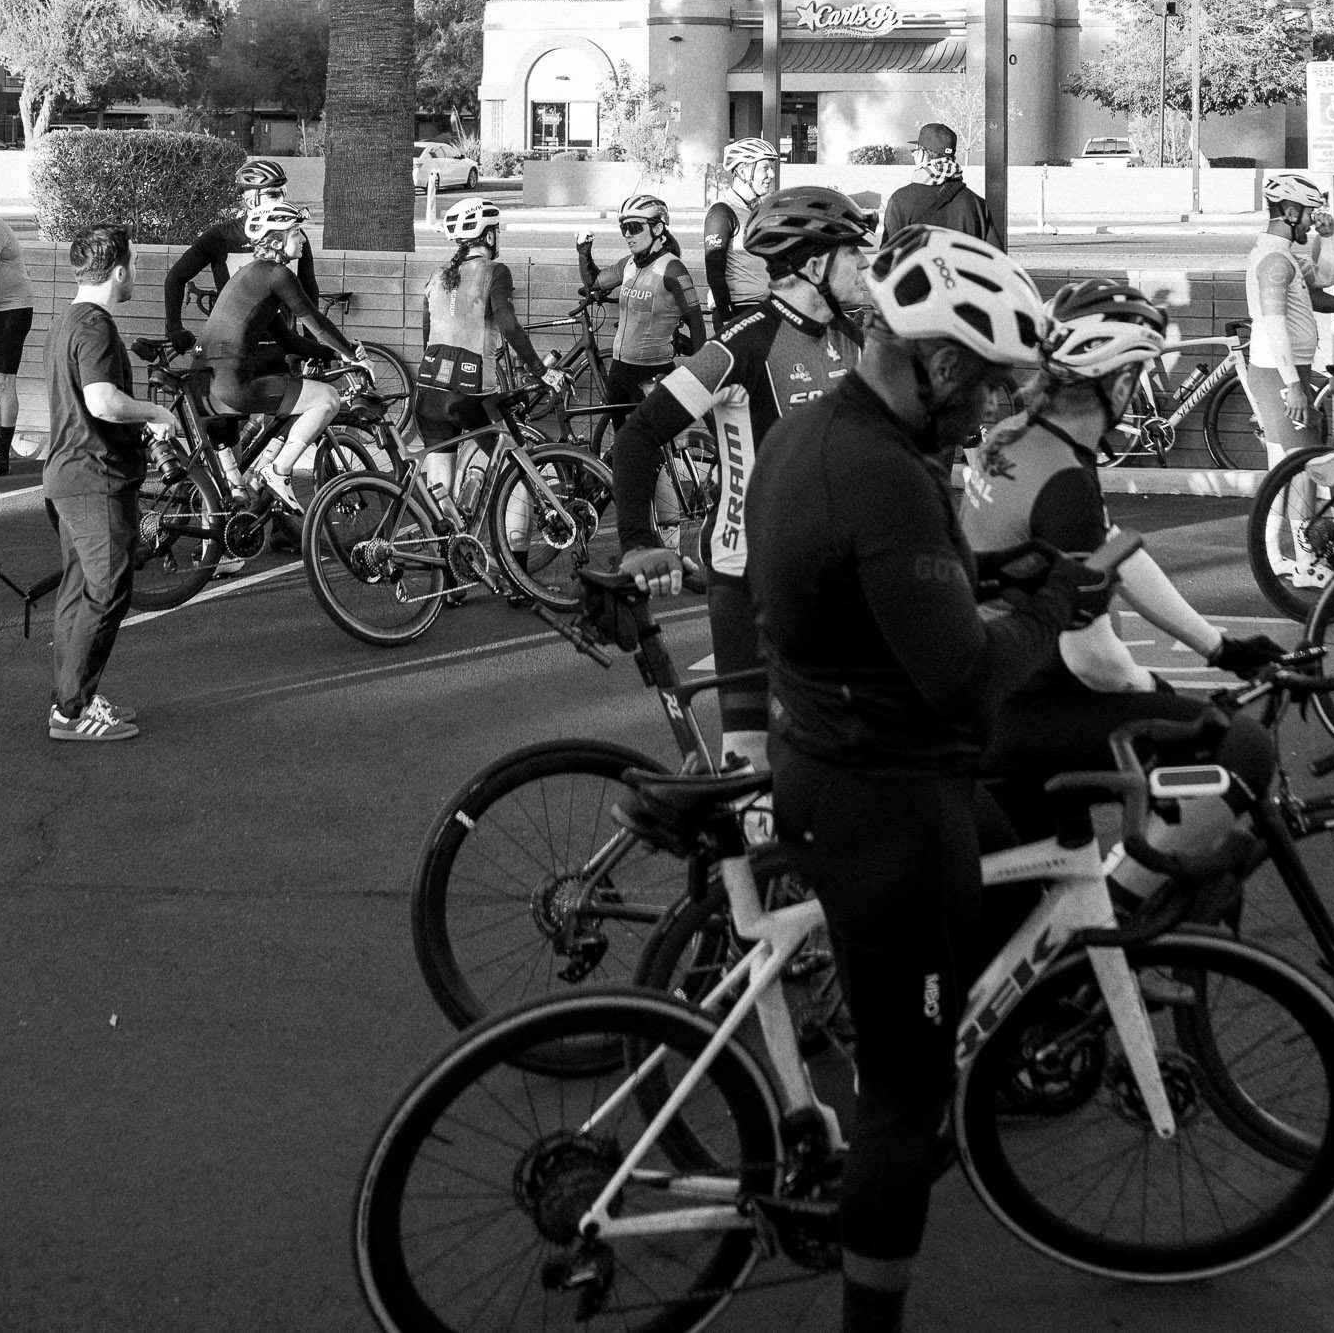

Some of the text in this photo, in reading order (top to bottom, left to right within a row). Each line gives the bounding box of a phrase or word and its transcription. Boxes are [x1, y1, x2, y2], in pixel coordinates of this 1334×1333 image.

[814, 3, 868, 28] Carl's
[932, 257, 955, 289] POC
[720, 311, 765, 343] SRAM
[771, 298, 804, 326] SRAM
[722, 423, 744, 551] SRAM
